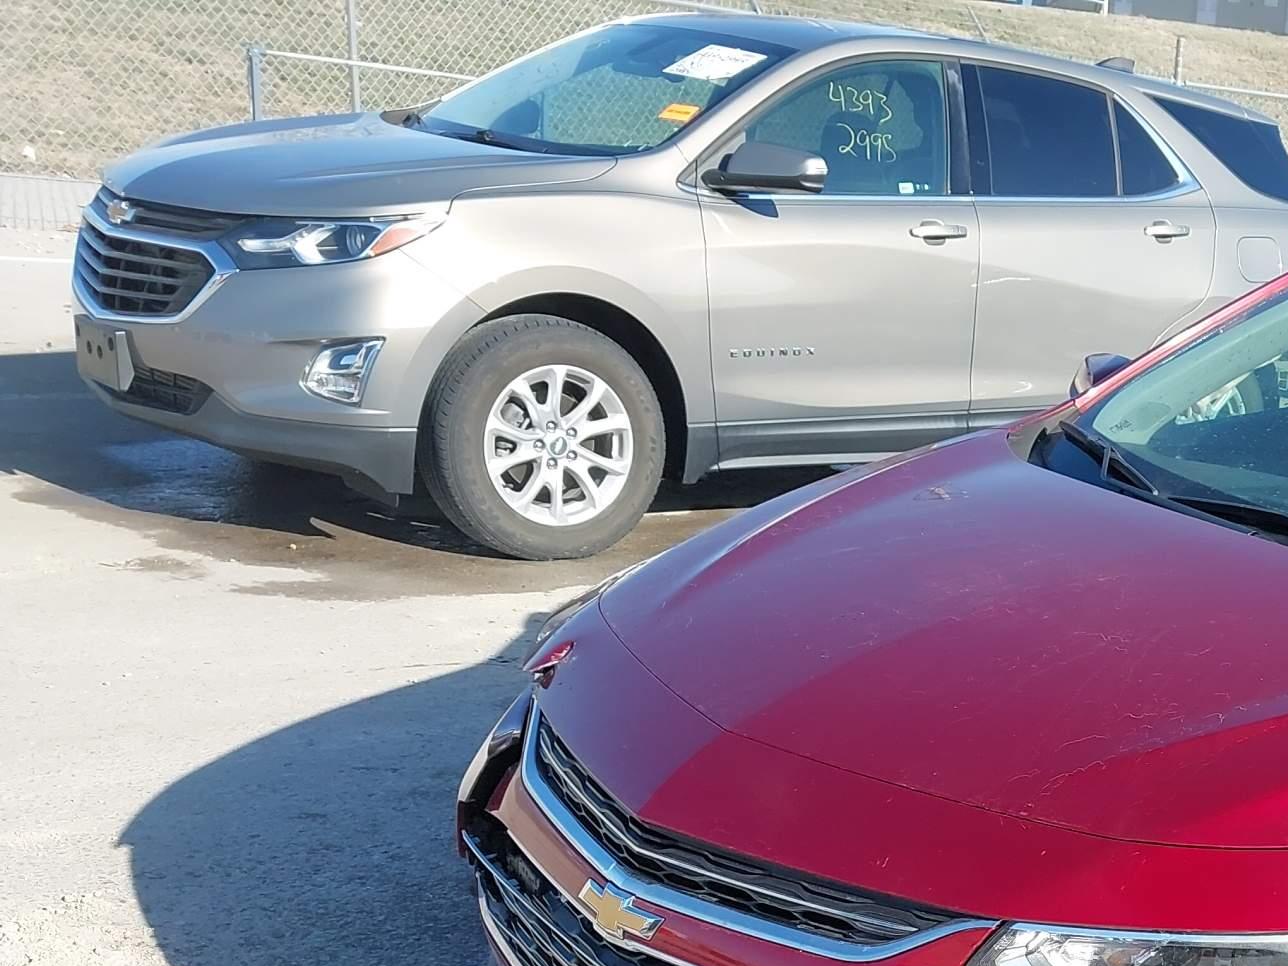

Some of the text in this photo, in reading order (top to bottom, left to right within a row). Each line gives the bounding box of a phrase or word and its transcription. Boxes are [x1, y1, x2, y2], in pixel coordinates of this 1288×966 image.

[829, 82, 893, 124] 4393
[836, 123, 897, 163] 2995
[729, 347, 816, 359] EQUINOX
